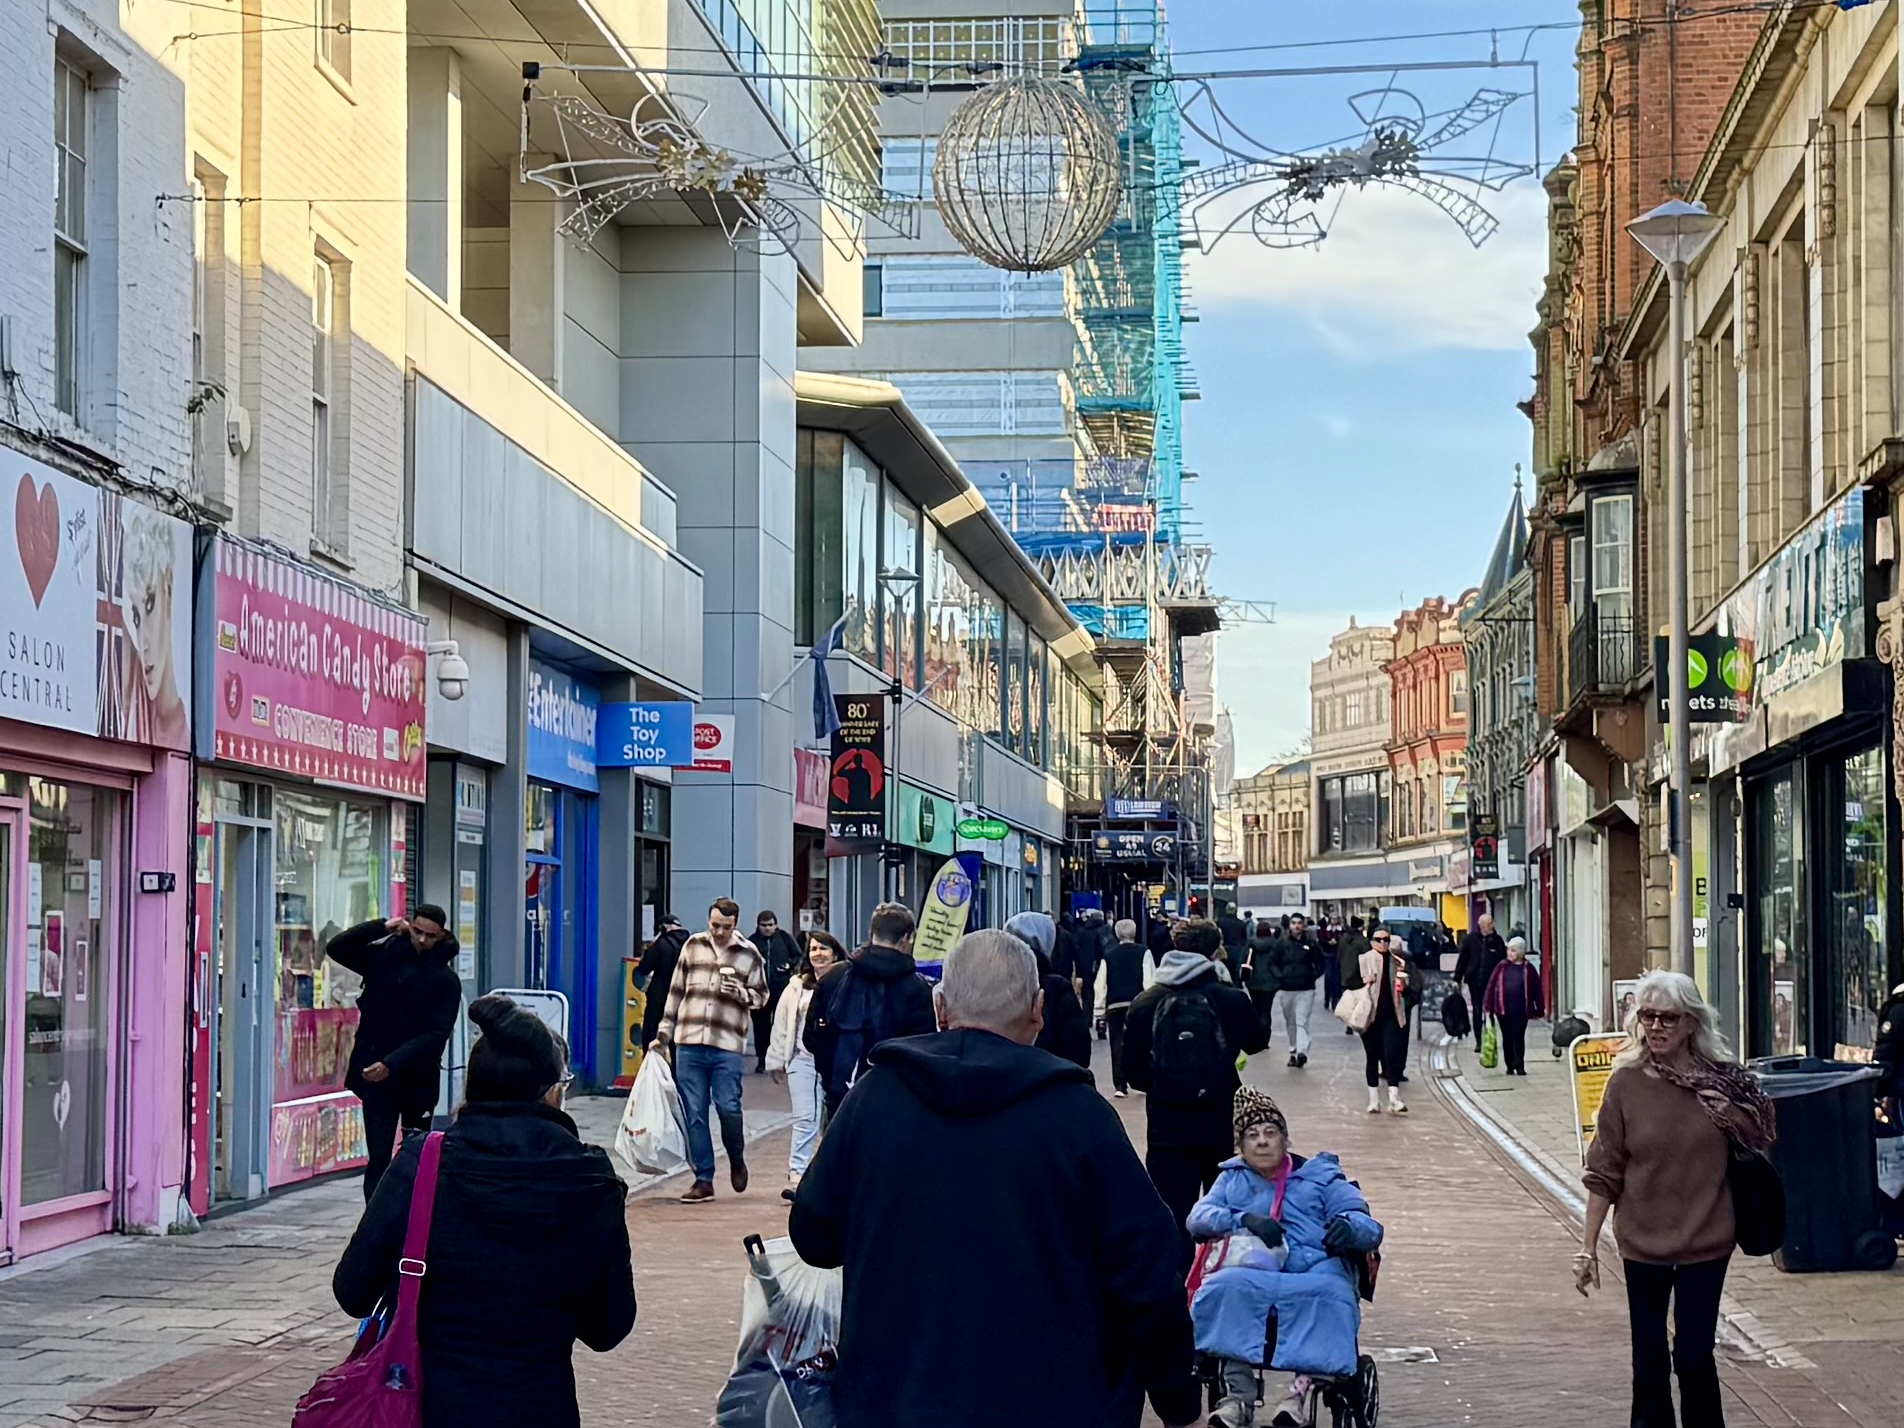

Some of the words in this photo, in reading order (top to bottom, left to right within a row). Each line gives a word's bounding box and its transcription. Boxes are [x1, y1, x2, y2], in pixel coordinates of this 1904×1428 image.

[8, 630, 65, 673] SALON
[239, 593, 318, 673] American
[322, 623, 371, 716] Candy
[373, 640, 411, 703] Store
[0, 670, 72, 713] CENTRAL
[629, 706, 660, 723] The
[847, 702, 870, 719] 80
[275, 703, 344, 753] CONVENIENCE
[346, 722, 378, 760] STORE
[630, 725, 660, 745] Toy
[694, 727, 714, 736] OST
[623, 744, 667, 763] Shop
